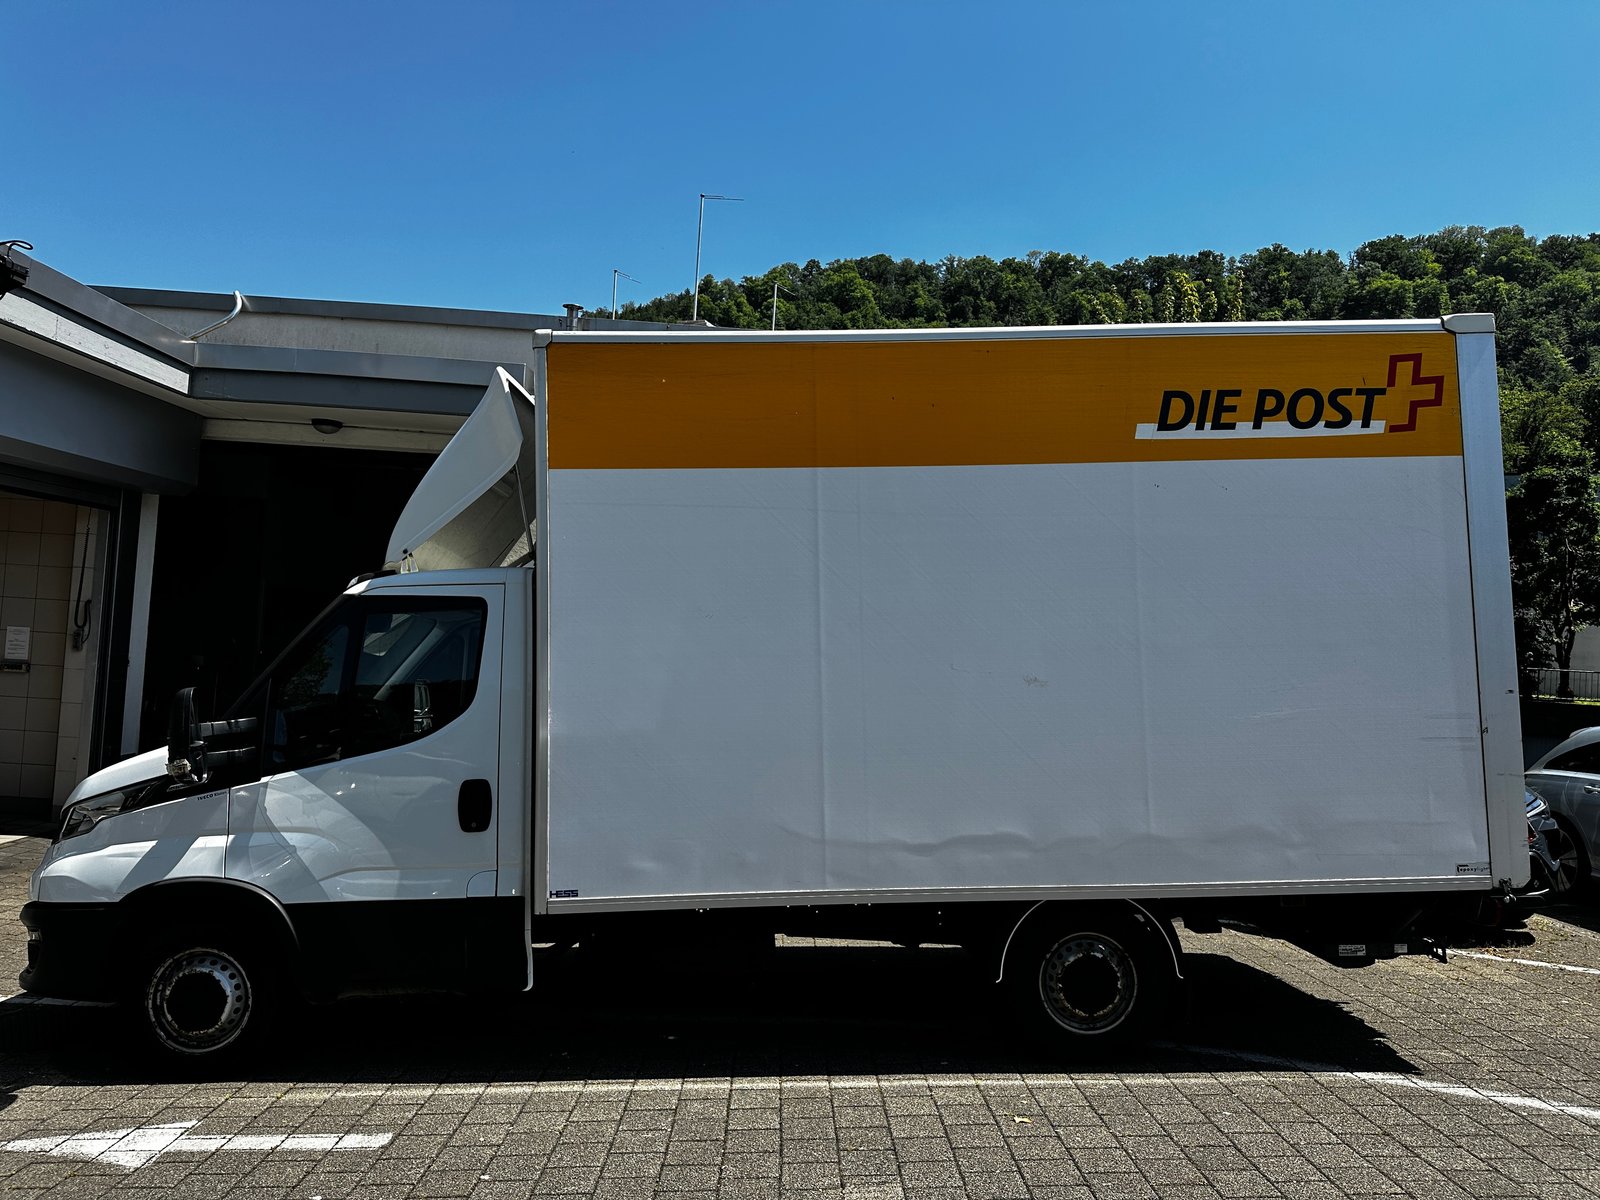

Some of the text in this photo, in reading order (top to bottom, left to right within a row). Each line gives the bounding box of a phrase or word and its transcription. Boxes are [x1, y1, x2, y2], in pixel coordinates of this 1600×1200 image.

[1157, 387, 1387, 432] DIE POST
[197, 793, 214, 801] IVECO
[550, 890, 579, 899] HESS
